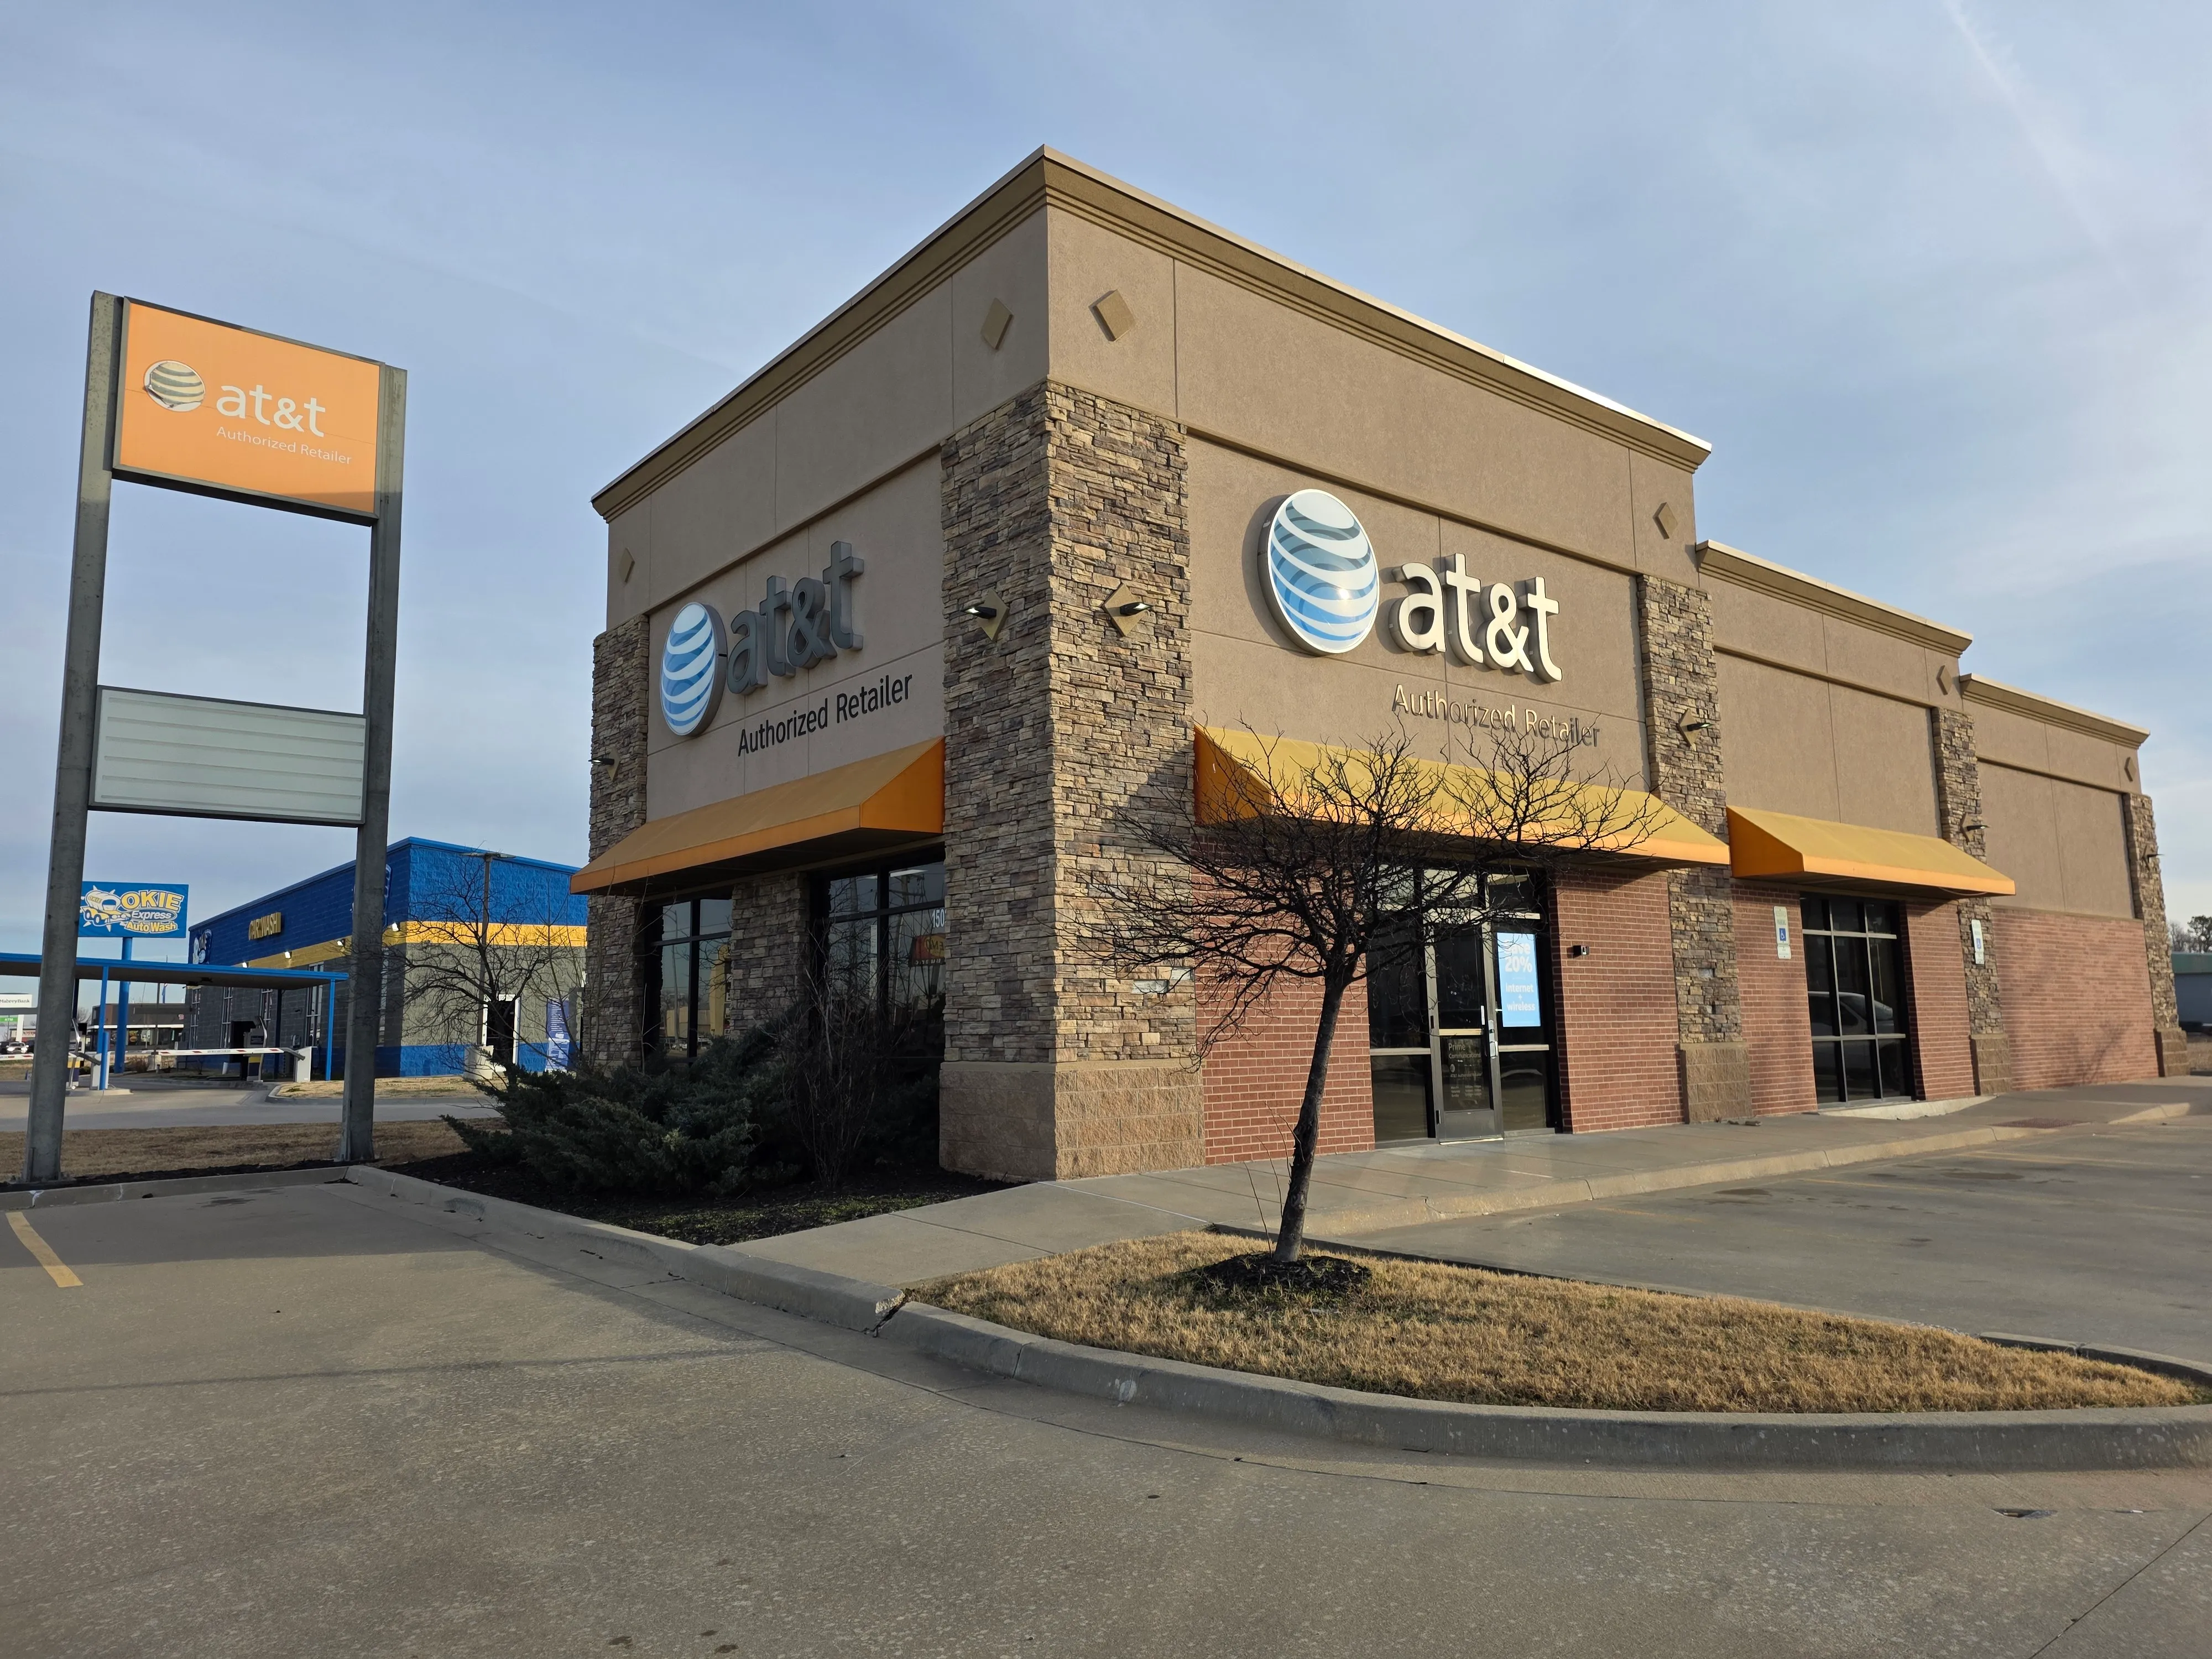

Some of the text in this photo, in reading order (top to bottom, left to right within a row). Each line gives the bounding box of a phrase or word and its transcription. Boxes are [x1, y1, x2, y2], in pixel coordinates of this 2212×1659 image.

[216, 385, 325, 437] at&t
[216, 426, 352, 465] Authorized Retailer
[727, 540, 864, 695] at&t
[1389, 553, 1563, 684] at&t
[738, 674, 912, 757] Authorized Retailer
[1392, 684, 1600, 747] Authorized Retailer
[88, 895, 102, 904] OKIE
[121, 890, 184, 912] OKIE
[127, 921, 176, 932] Auto Wash
[132, 910, 172, 921] Express
[249, 912, 281, 940] CAR WASH
[932, 909, 947, 928] 150
[1505, 956, 1532, 973] 20%
[1507, 1001, 1535, 1011] wireless
